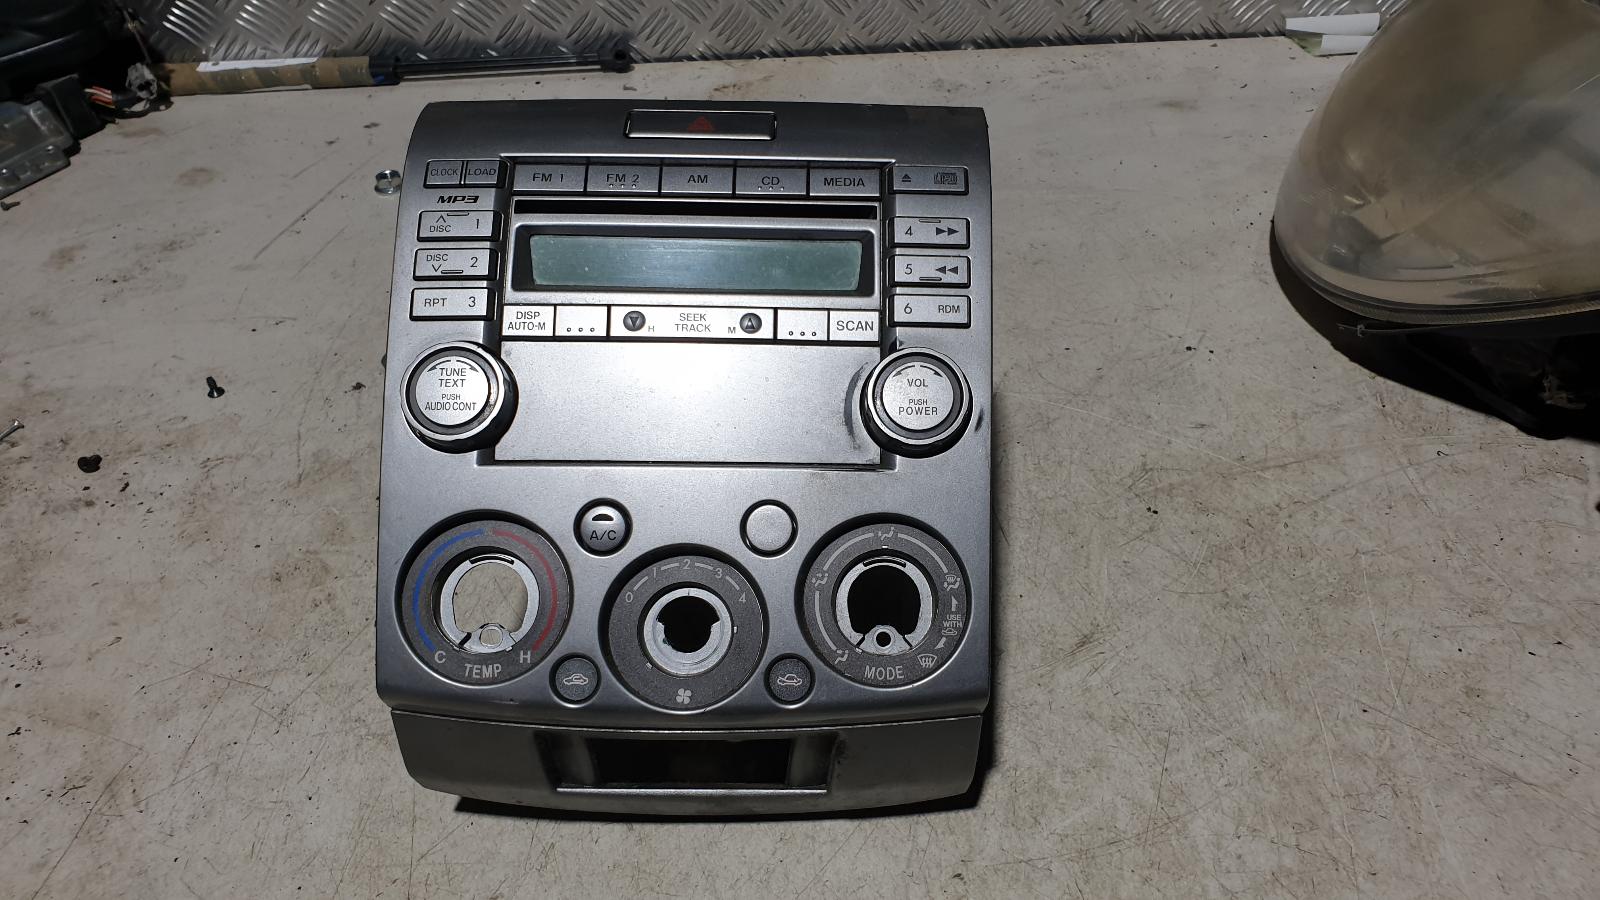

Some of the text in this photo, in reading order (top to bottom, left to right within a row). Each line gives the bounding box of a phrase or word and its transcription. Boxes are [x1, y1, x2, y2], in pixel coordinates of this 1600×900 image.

[430, 167, 458, 176] CLOCK
[467, 167, 496, 176] LOAD
[532, 172, 564, 182] FM 1
[606, 174, 640, 183] FM 2
[688, 174, 708, 184] AM
[761, 176, 780, 186] CD
[823, 177, 866, 187] MEDIA
[436, 194, 480, 204] MP3
[429, 224, 452, 233] DISC
[474, 218, 480, 229] 1
[904, 226, 913, 237] 4
[426, 253, 448, 262] DISC
[470, 256, 478, 268] 2
[904, 264, 913, 275] 5
[424, 298, 448, 307] RPT
[468, 296, 476, 308] 3
[904, 303, 912, 314] 6
[938, 304, 960, 314] RDM
[516, 310, 540, 320] DISP
[680, 312, 706, 322] SEEK
[508, 321, 546, 331] AUTO-M
[675, 324, 711, 332] TRACK
[728, 326, 736, 334] M
[836, 320, 874, 332] SCAN
[439, 368, 467, 376] TUNE
[438, 378, 466, 388] TEXT
[907, 378, 928, 388] VOL
[424, 402, 477, 410] AUDIO CONT
[898, 406, 938, 416] POWER
[590, 530, 617, 542] A/C
[682, 558, 691, 570] 2
[652, 568, 658, 578] 1
[714, 568, 723, 579] 3
[625, 592, 634, 603] 0
[738, 592, 747, 604] 4
[434, 650, 446, 664] C
[520, 650, 531, 664] H
[464, 664, 502, 679] TEMP
[864, 666, 905, 680] MODE
